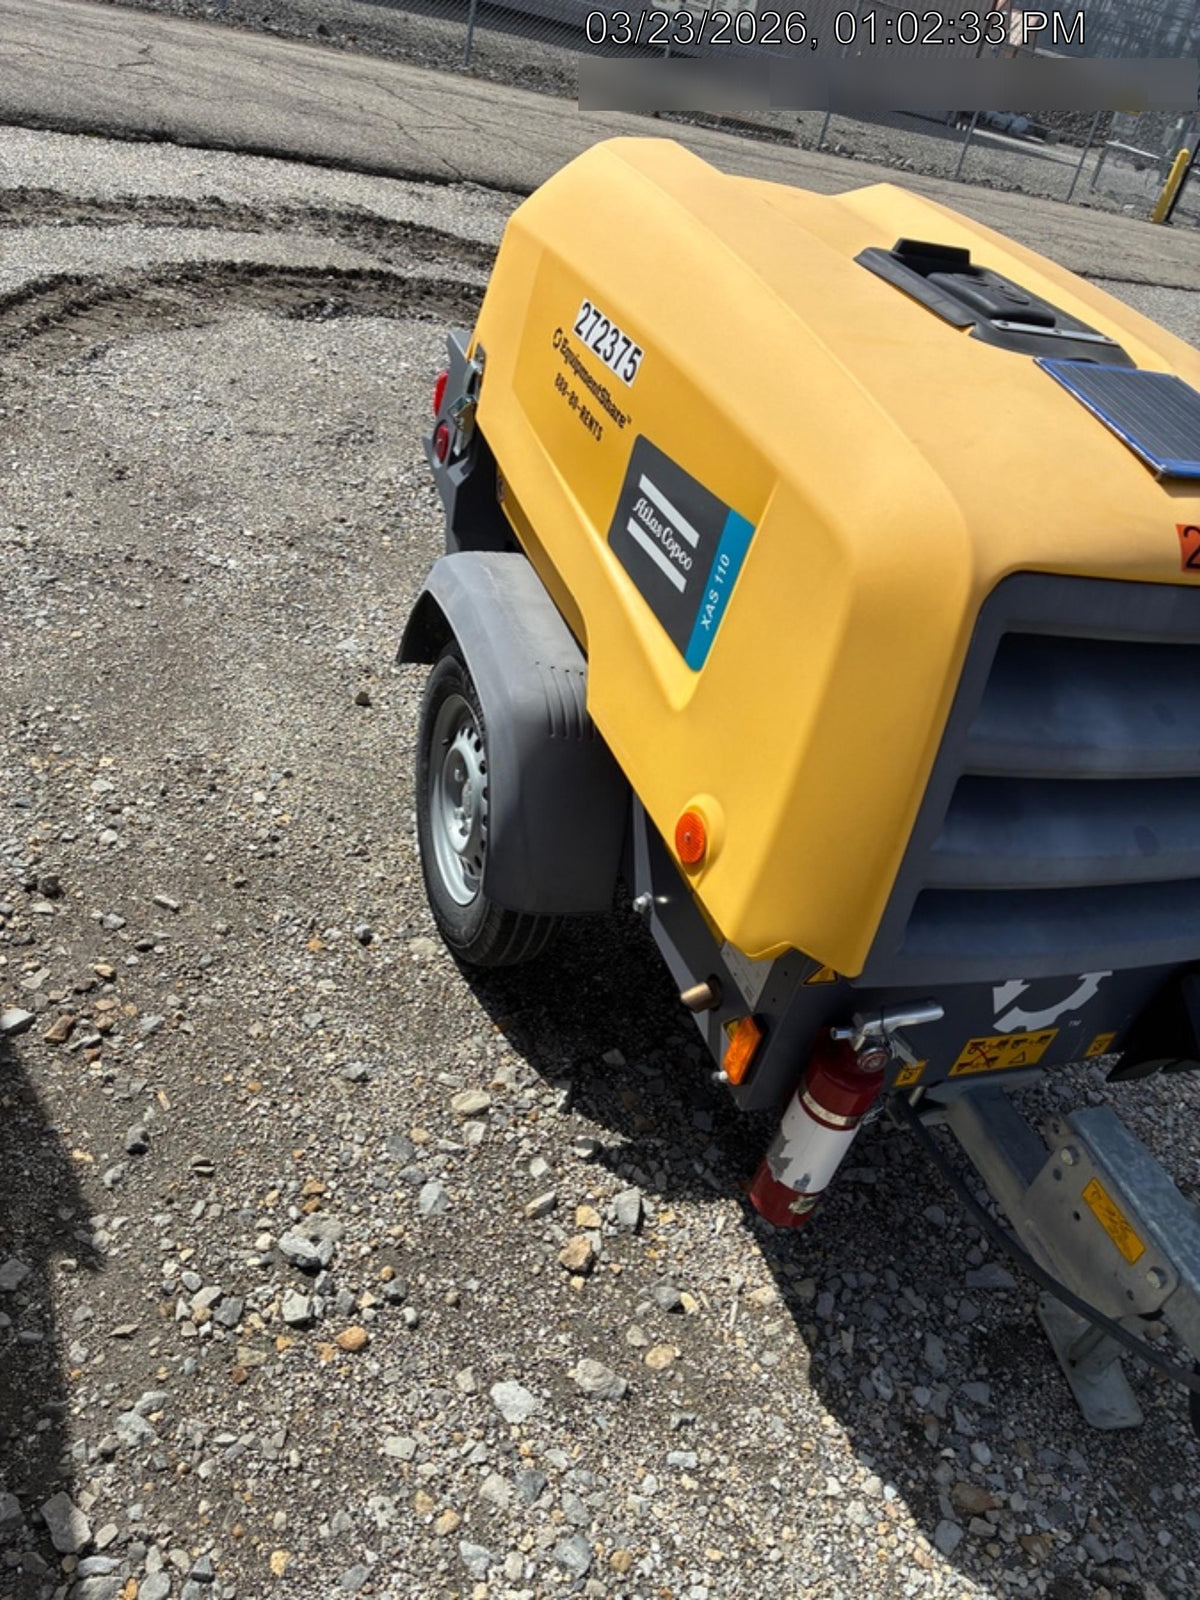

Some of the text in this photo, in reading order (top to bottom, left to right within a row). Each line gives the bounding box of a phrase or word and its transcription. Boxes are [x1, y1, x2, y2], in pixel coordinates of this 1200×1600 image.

[559, 337, 627, 429] EquipmentShare
[573, 301, 643, 383] 272375
[700, 553, 730, 631] XAS 110
